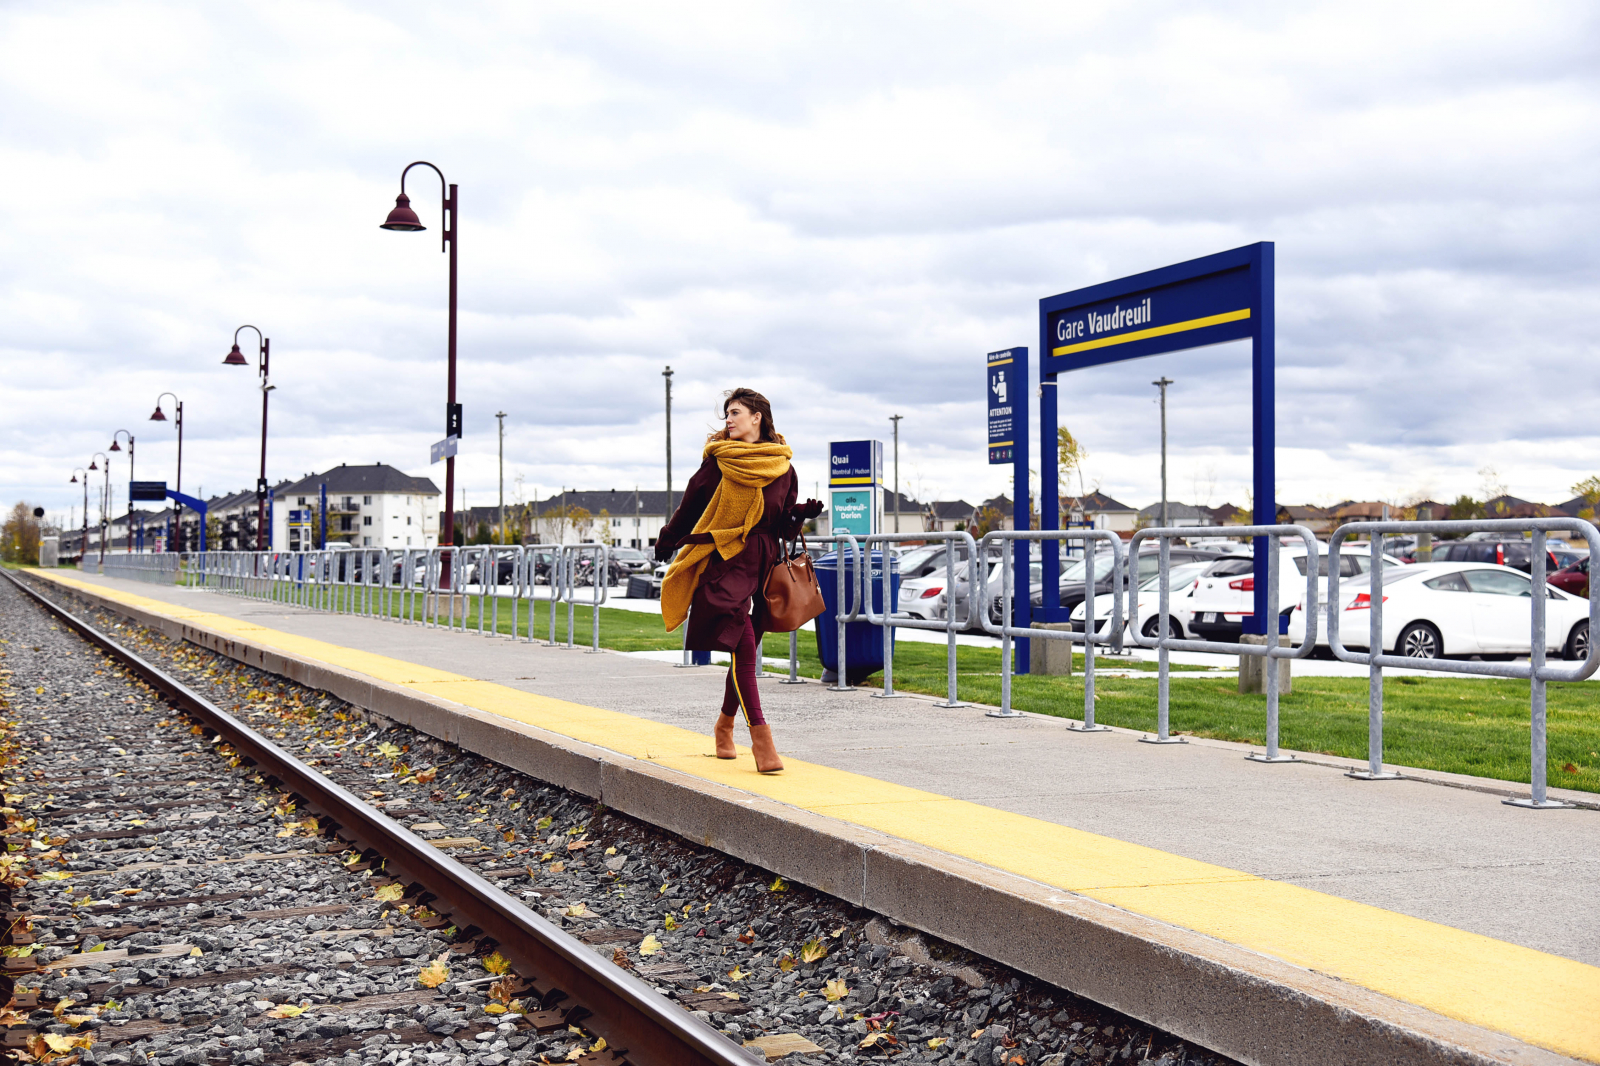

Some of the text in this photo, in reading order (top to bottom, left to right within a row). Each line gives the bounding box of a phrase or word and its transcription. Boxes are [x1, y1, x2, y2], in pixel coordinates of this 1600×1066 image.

[1057, 297, 1151, 341] Gare Vaudreuil
[989, 406, 1012, 417] ATTENTION
[832, 454, 849, 465] Quai
[834, 503, 867, 511] Vaudreuil-
